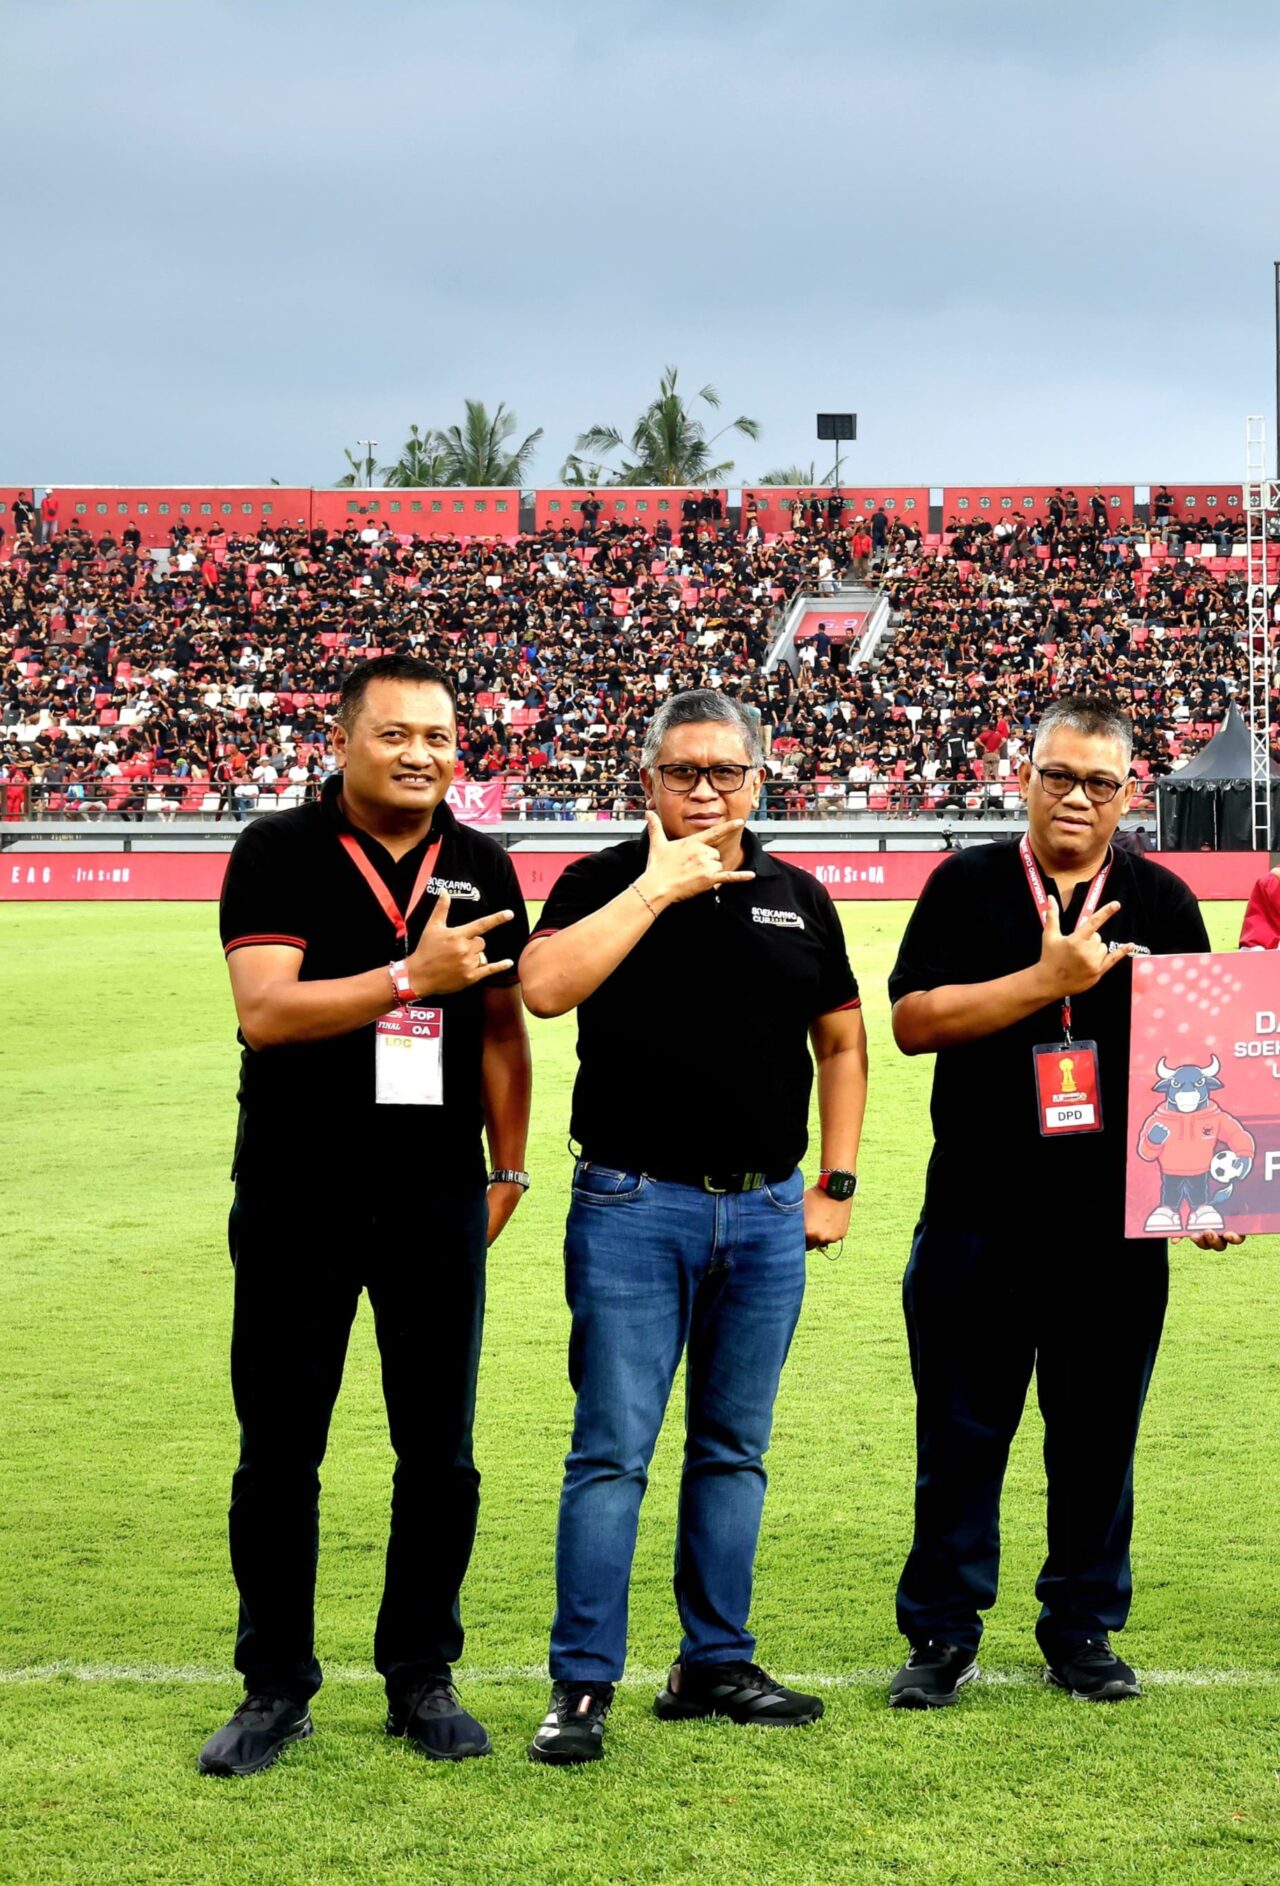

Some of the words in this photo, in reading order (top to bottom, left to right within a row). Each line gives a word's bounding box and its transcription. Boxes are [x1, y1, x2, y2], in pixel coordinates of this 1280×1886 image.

[751, 907, 797, 920] SOEKARNO
[410, 1010, 435, 1020] FOP
[412, 1025, 430, 1036] OA
[1057, 1110, 1082, 1121] DPD
